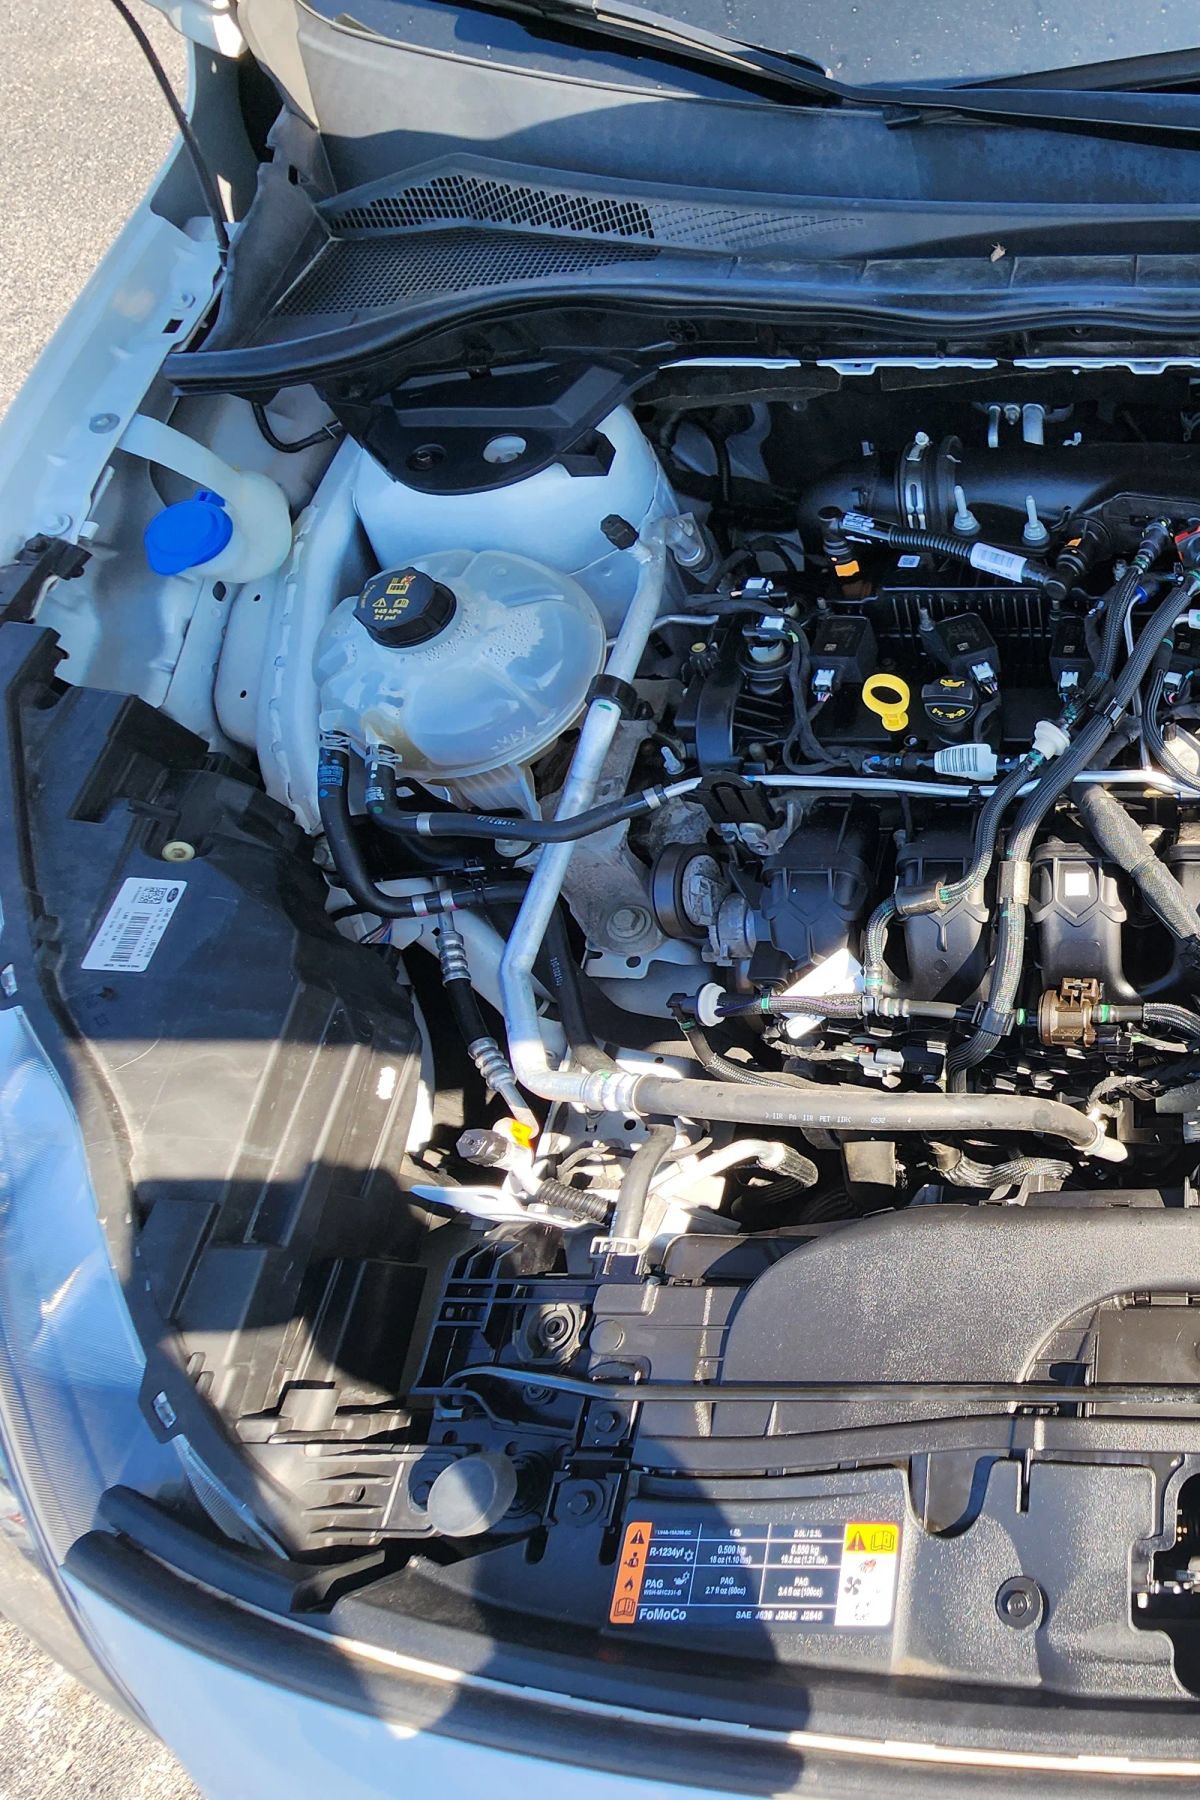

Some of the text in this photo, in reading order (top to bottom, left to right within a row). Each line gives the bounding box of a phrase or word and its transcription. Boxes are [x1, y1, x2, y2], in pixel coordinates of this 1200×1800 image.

[649, 1547, 685, 1559] R-1234yf
[717, 1545, 747, 1556] 0.500 kg
[809, 1543, 820, 1556] kg
[717, 1556, 725, 1564] oz
[725, 1555, 740, 1565] (1.10
[645, 1579, 664, 1588] PAG
[719, 1576, 734, 1585] PAG
[793, 1576, 810, 1586] PAG
[705, 1586, 714, 1595] 2.7
[720, 1587, 728, 1595] oz
[792, 1588, 801, 1597] oz
[639, 1608, 687, 1620] FoMoCo
[735, 1610, 752, 1619] SAE
